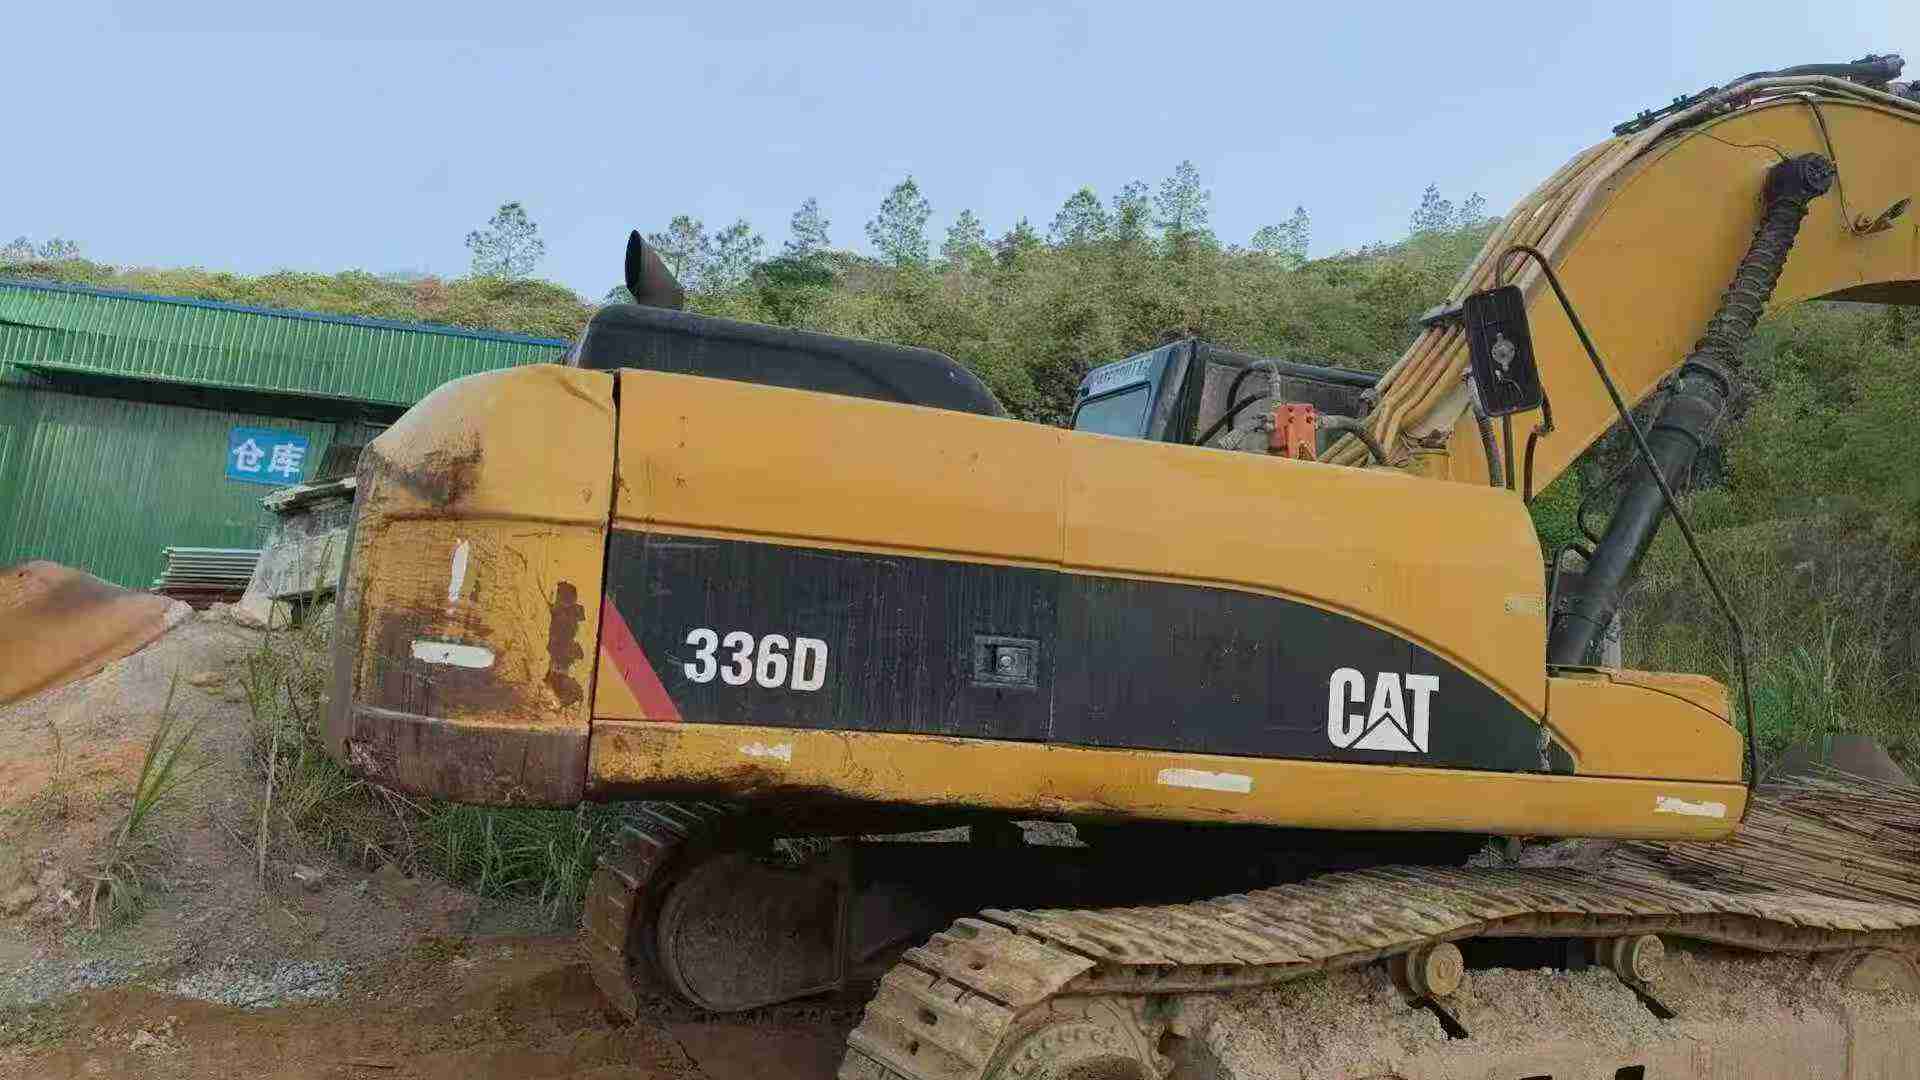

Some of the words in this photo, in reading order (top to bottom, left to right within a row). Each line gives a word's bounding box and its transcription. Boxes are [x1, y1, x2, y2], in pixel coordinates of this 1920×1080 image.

[232, 438, 304, 477] 仓库
[684, 628, 828, 691] 336D
[1328, 667, 1440, 753] CAT
